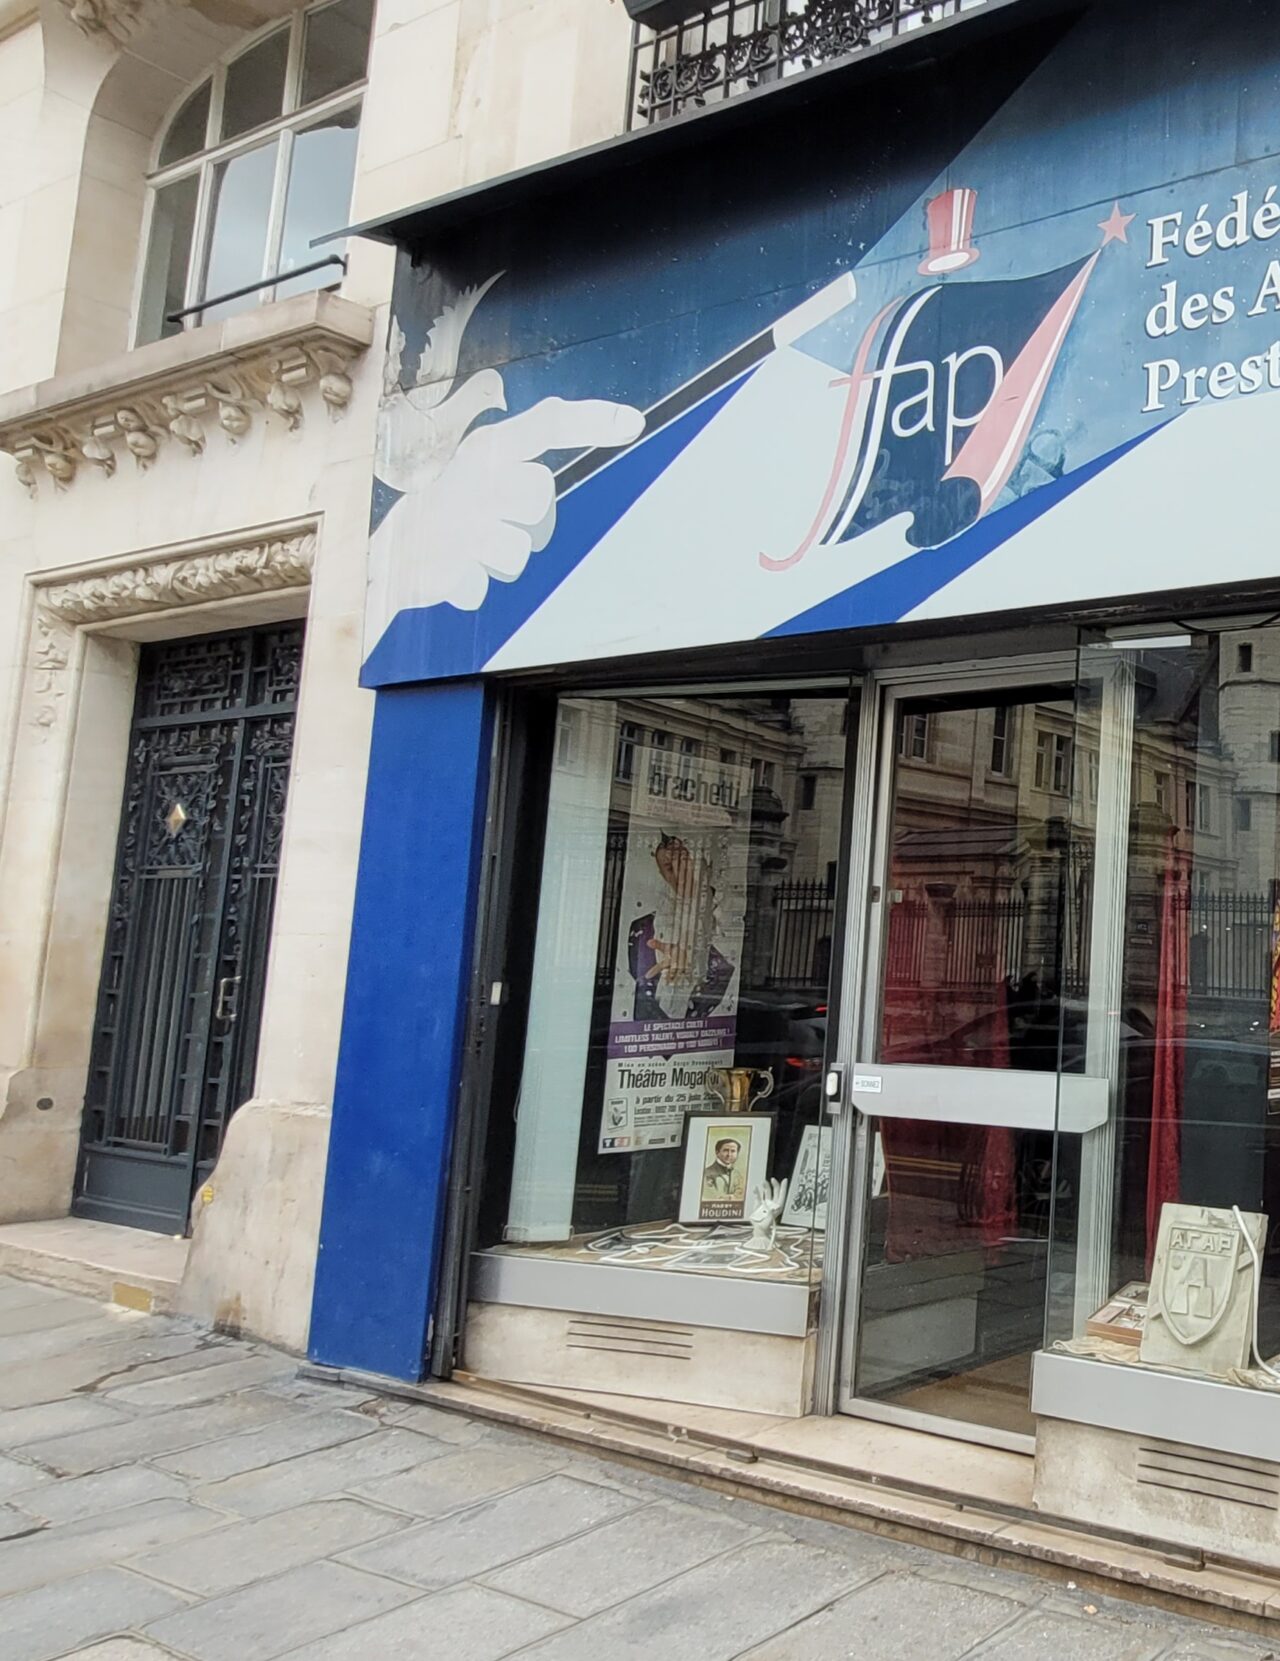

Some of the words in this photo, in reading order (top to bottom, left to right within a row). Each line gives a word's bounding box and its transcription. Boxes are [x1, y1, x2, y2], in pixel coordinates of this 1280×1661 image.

[1145, 281, 1236, 339] des
[648, 766, 741, 809] brachetti
[617, 1068, 667, 1089] Théâtre
[701, 1208, 742, 1217] HOUDINI
